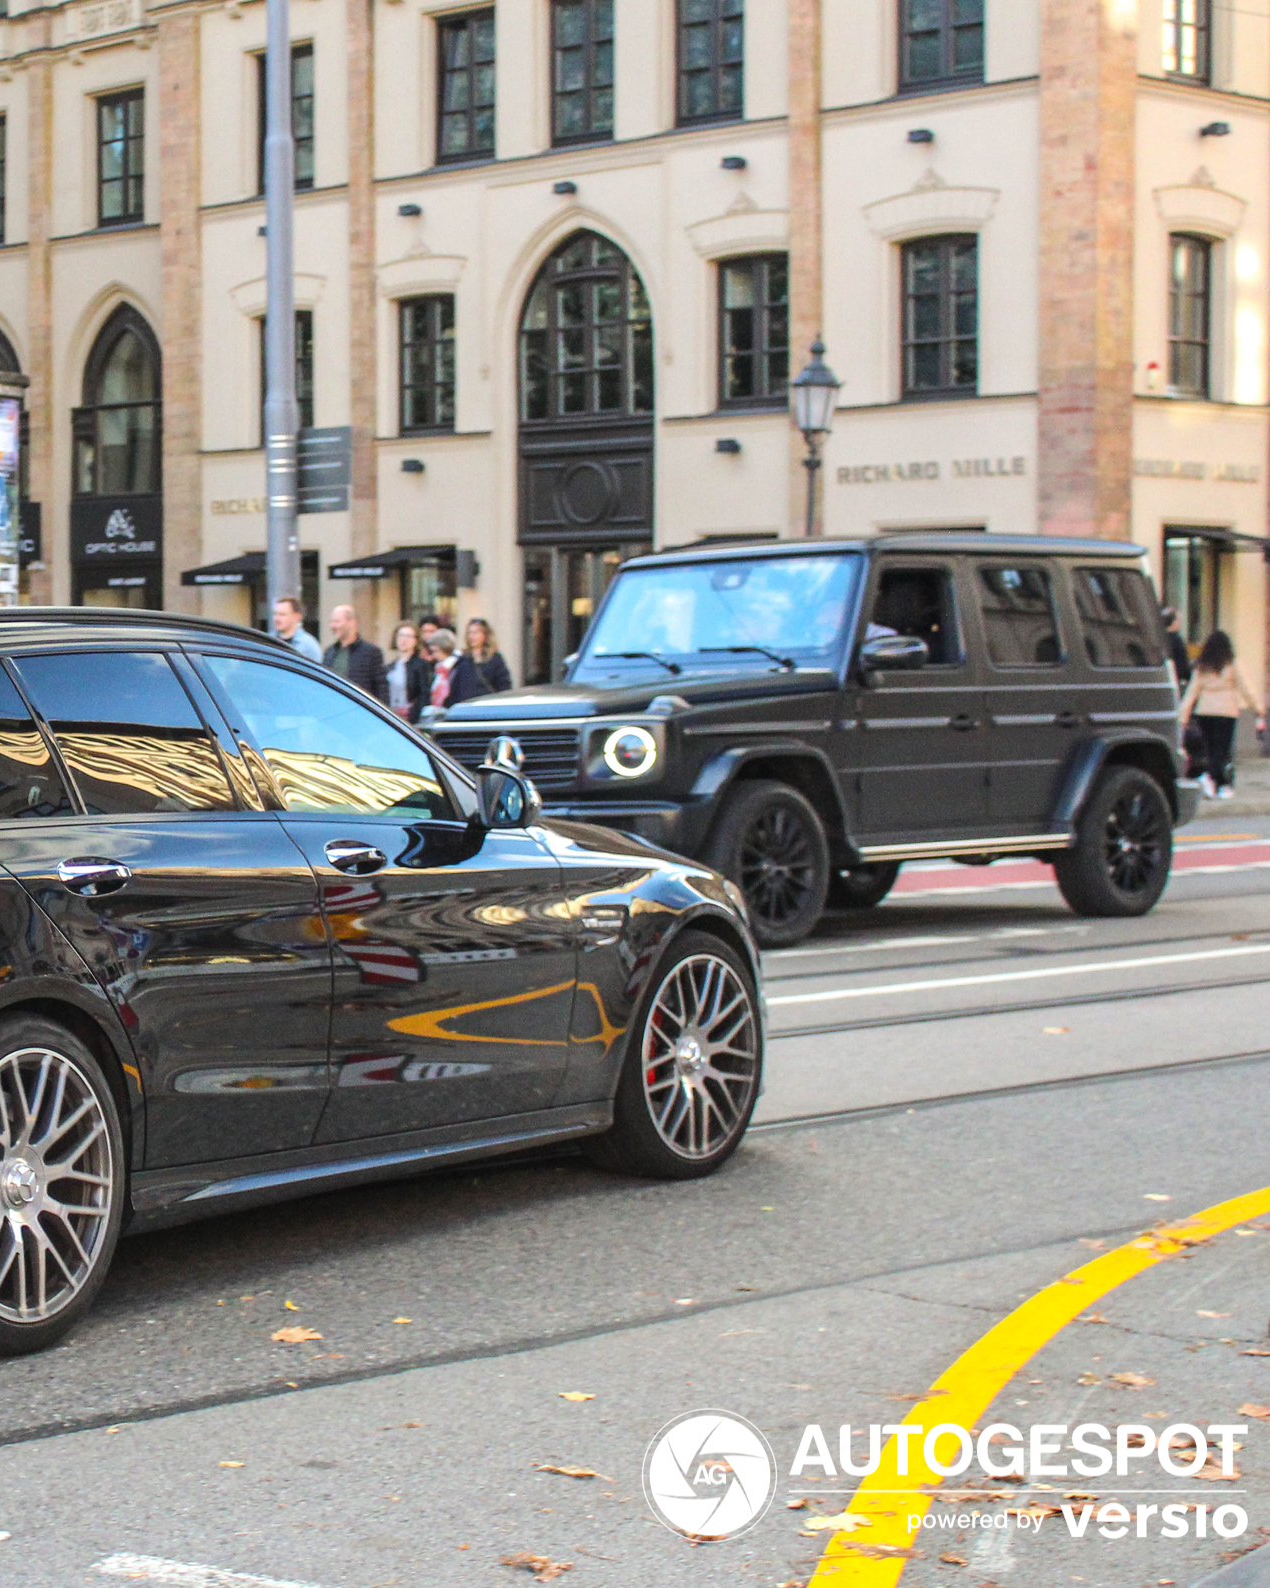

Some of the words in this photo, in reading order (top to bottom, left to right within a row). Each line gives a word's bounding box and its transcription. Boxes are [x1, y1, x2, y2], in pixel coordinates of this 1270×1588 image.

[837, 461, 940, 484] RICHARD
[952, 456, 1026, 478] MILLE
[85, 543, 117, 554] OPTIC
[119, 540, 156, 553] HOUSE
